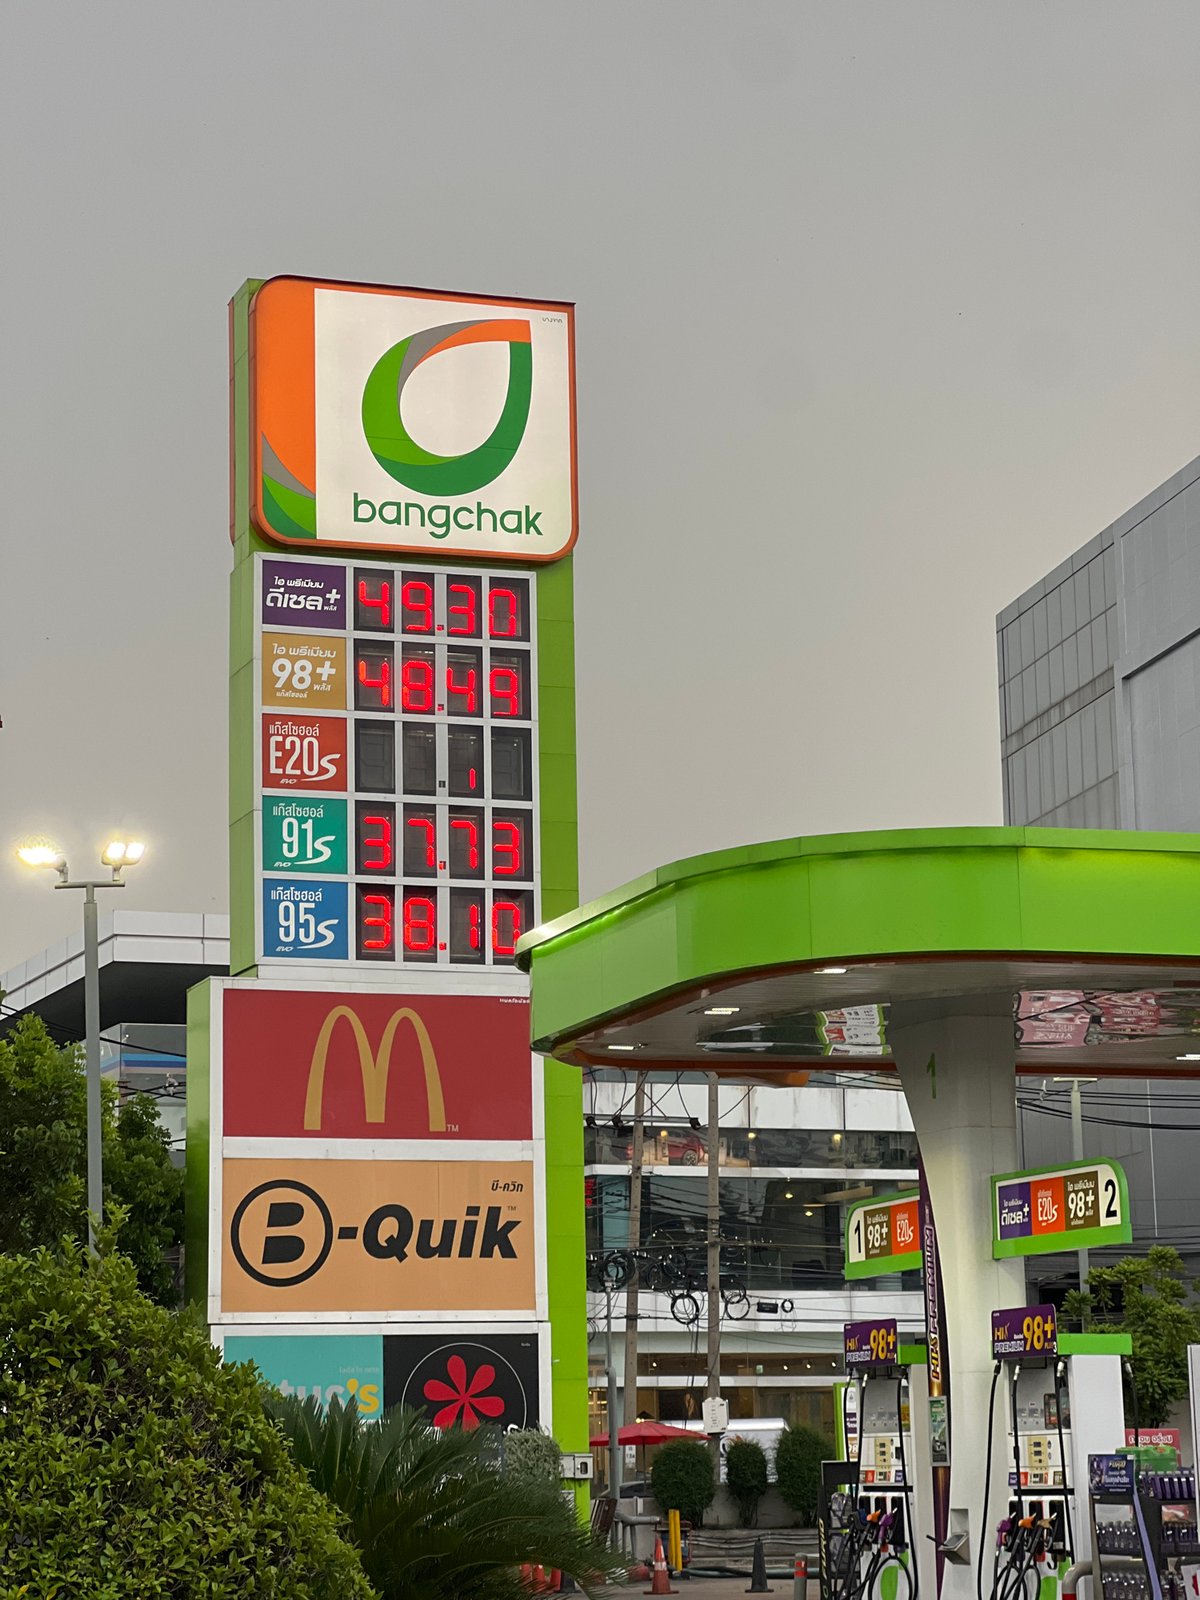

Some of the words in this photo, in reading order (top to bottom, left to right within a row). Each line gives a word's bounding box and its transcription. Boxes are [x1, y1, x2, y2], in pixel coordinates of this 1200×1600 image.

[353, 492, 543, 540] bangchak
[359, 580, 516, 637] 49.30
[358, 660, 518, 716] 48.49
[364, 816, 520, 874] 37.73
[1104, 1178, 1118, 1219] 2
[260, 1200, 522, 1266] B-Quik
[854, 1219, 862, 1254] 1
